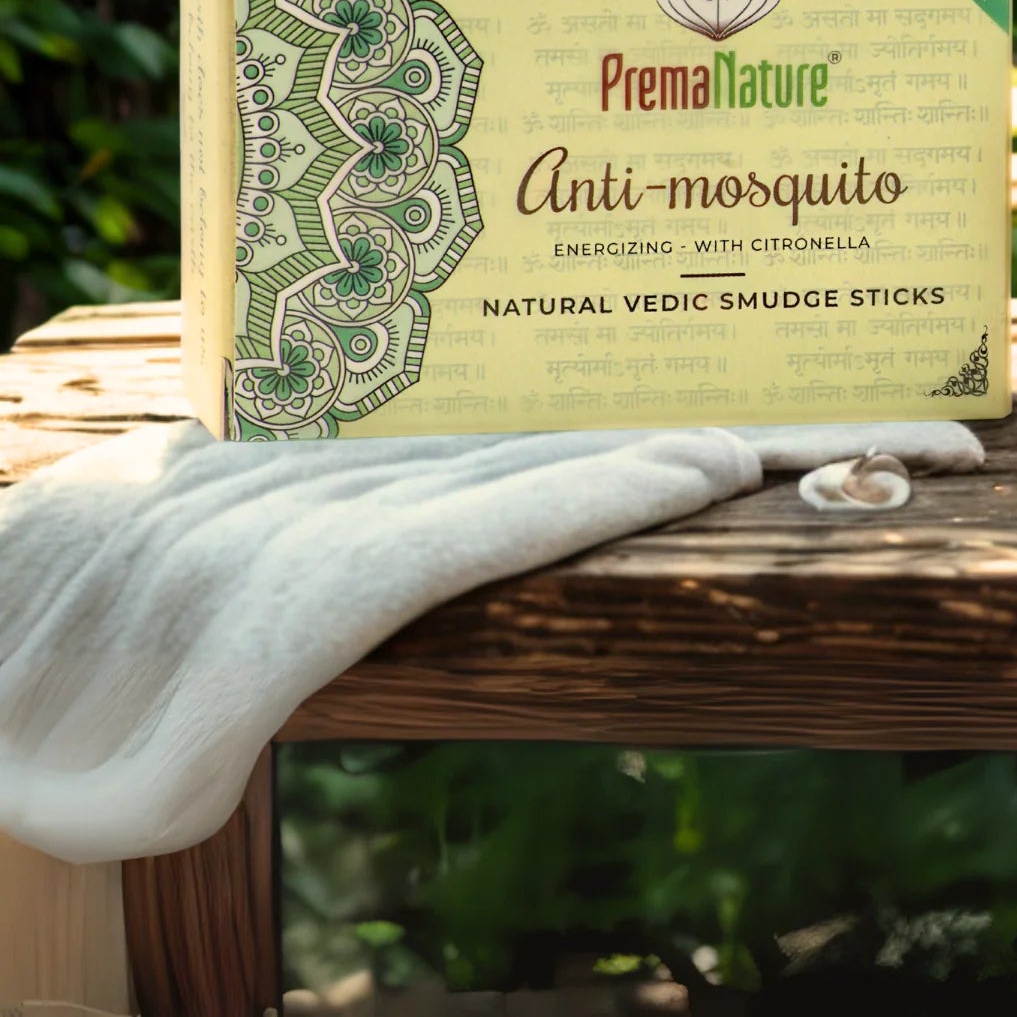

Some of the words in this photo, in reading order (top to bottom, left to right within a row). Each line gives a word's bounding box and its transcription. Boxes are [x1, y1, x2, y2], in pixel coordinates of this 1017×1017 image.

[516, 146, 908, 227] Anti-mosquito
[554, 241, 673, 257] ENERGIZING
[694, 239, 743, 253] WITH
[751, 236, 871, 252] CITRONELLA
[482, 296, 613, 317] NATURAL
[623, 293, 709, 313] VEDIC
[719, 289, 839, 310] SMUDGE
[850, 286, 945, 307] STICKS
